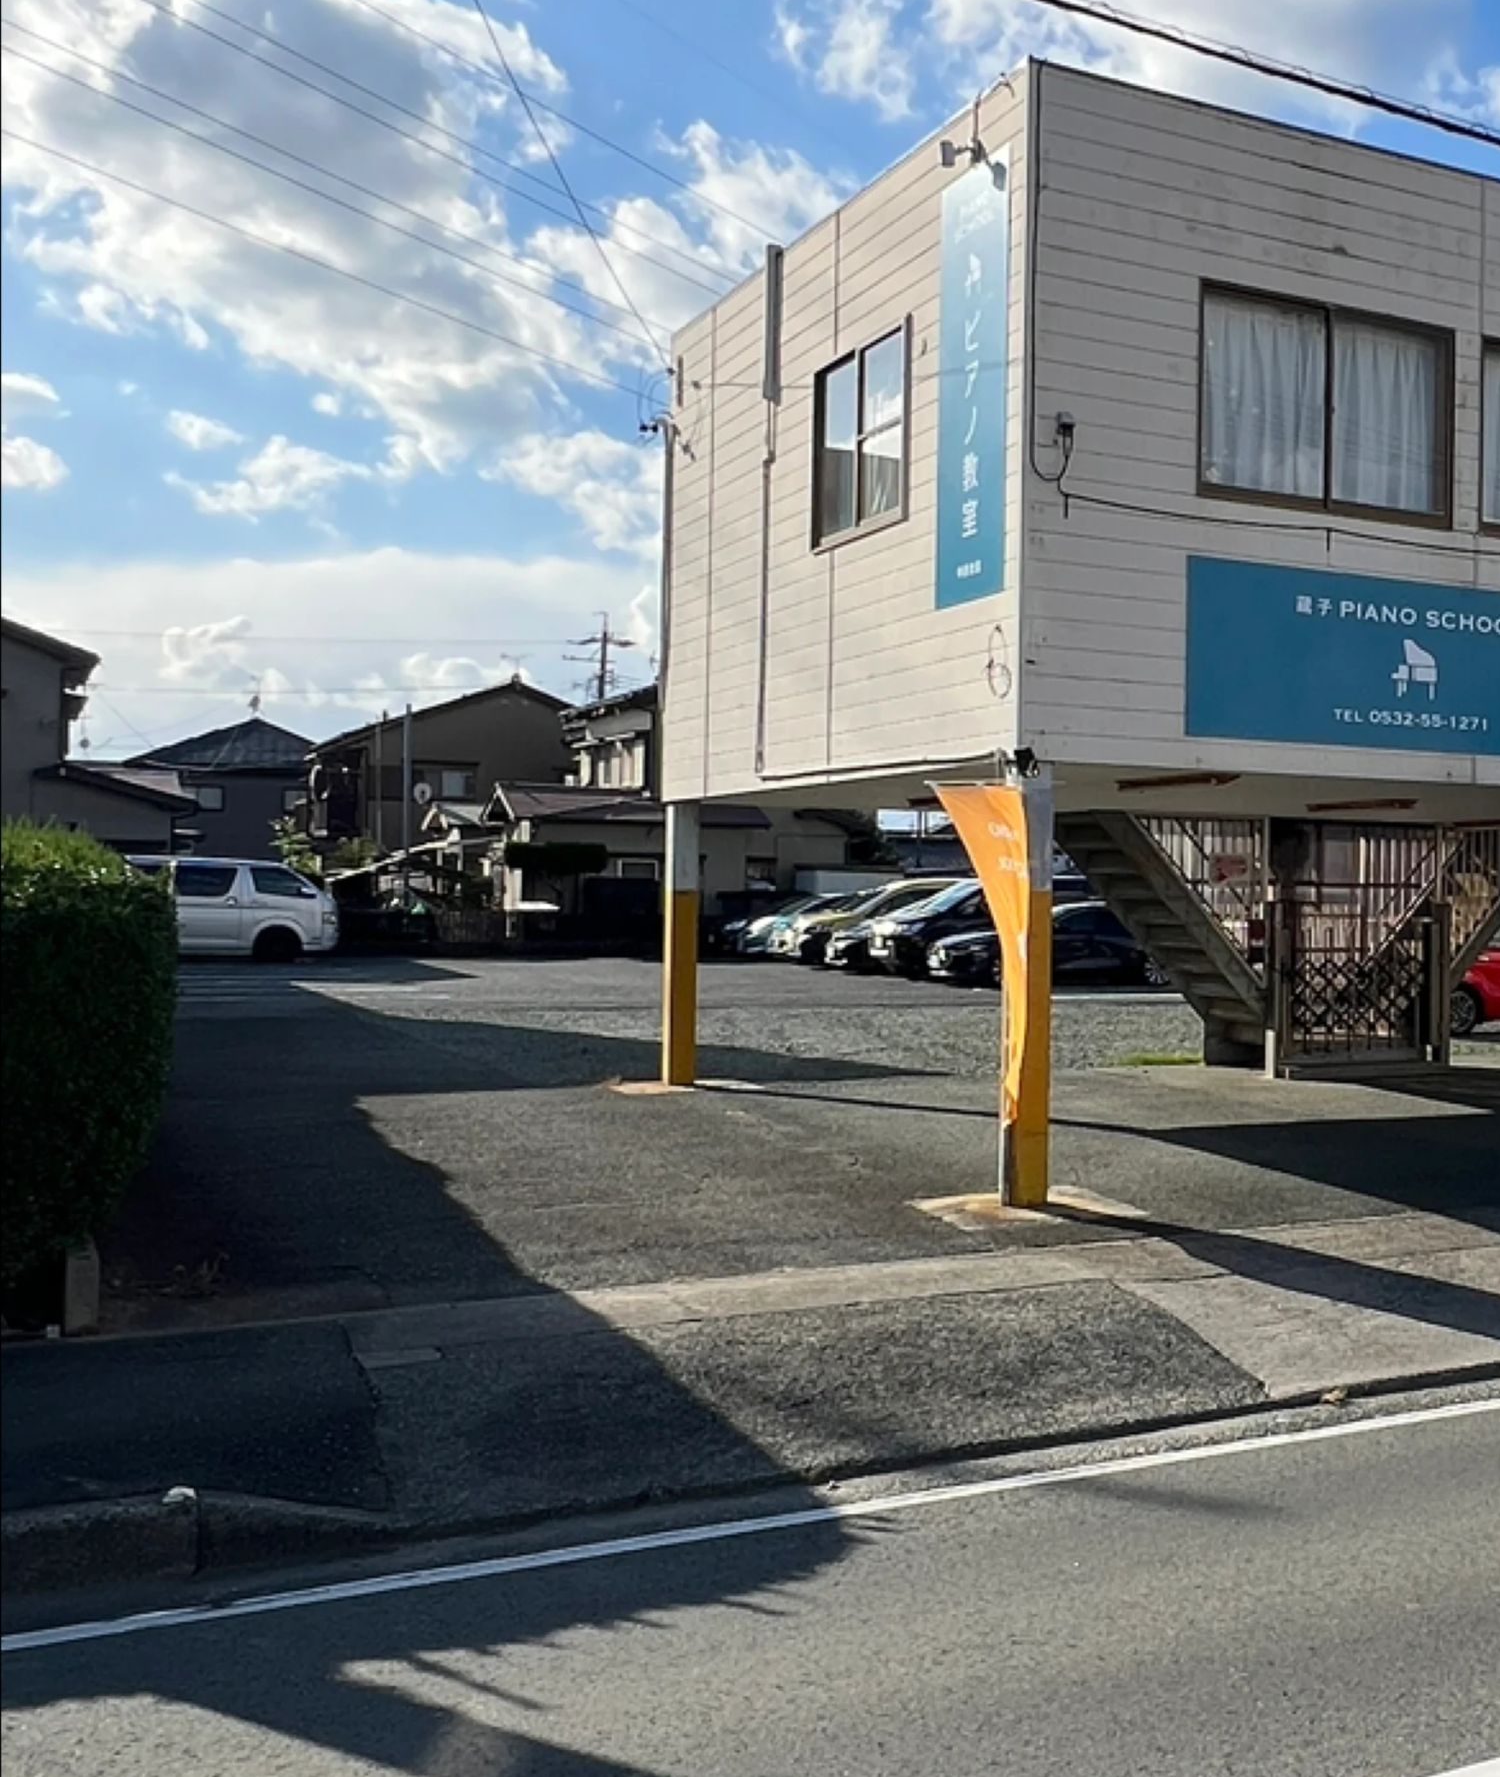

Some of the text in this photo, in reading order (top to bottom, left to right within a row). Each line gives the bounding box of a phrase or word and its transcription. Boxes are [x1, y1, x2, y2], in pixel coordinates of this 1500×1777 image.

[962, 309, 982, 539] ピアノ教室
[1339, 600, 1417, 626] PIANO
[1333, 708, 1488, 732] TEL 0532-55-1271
